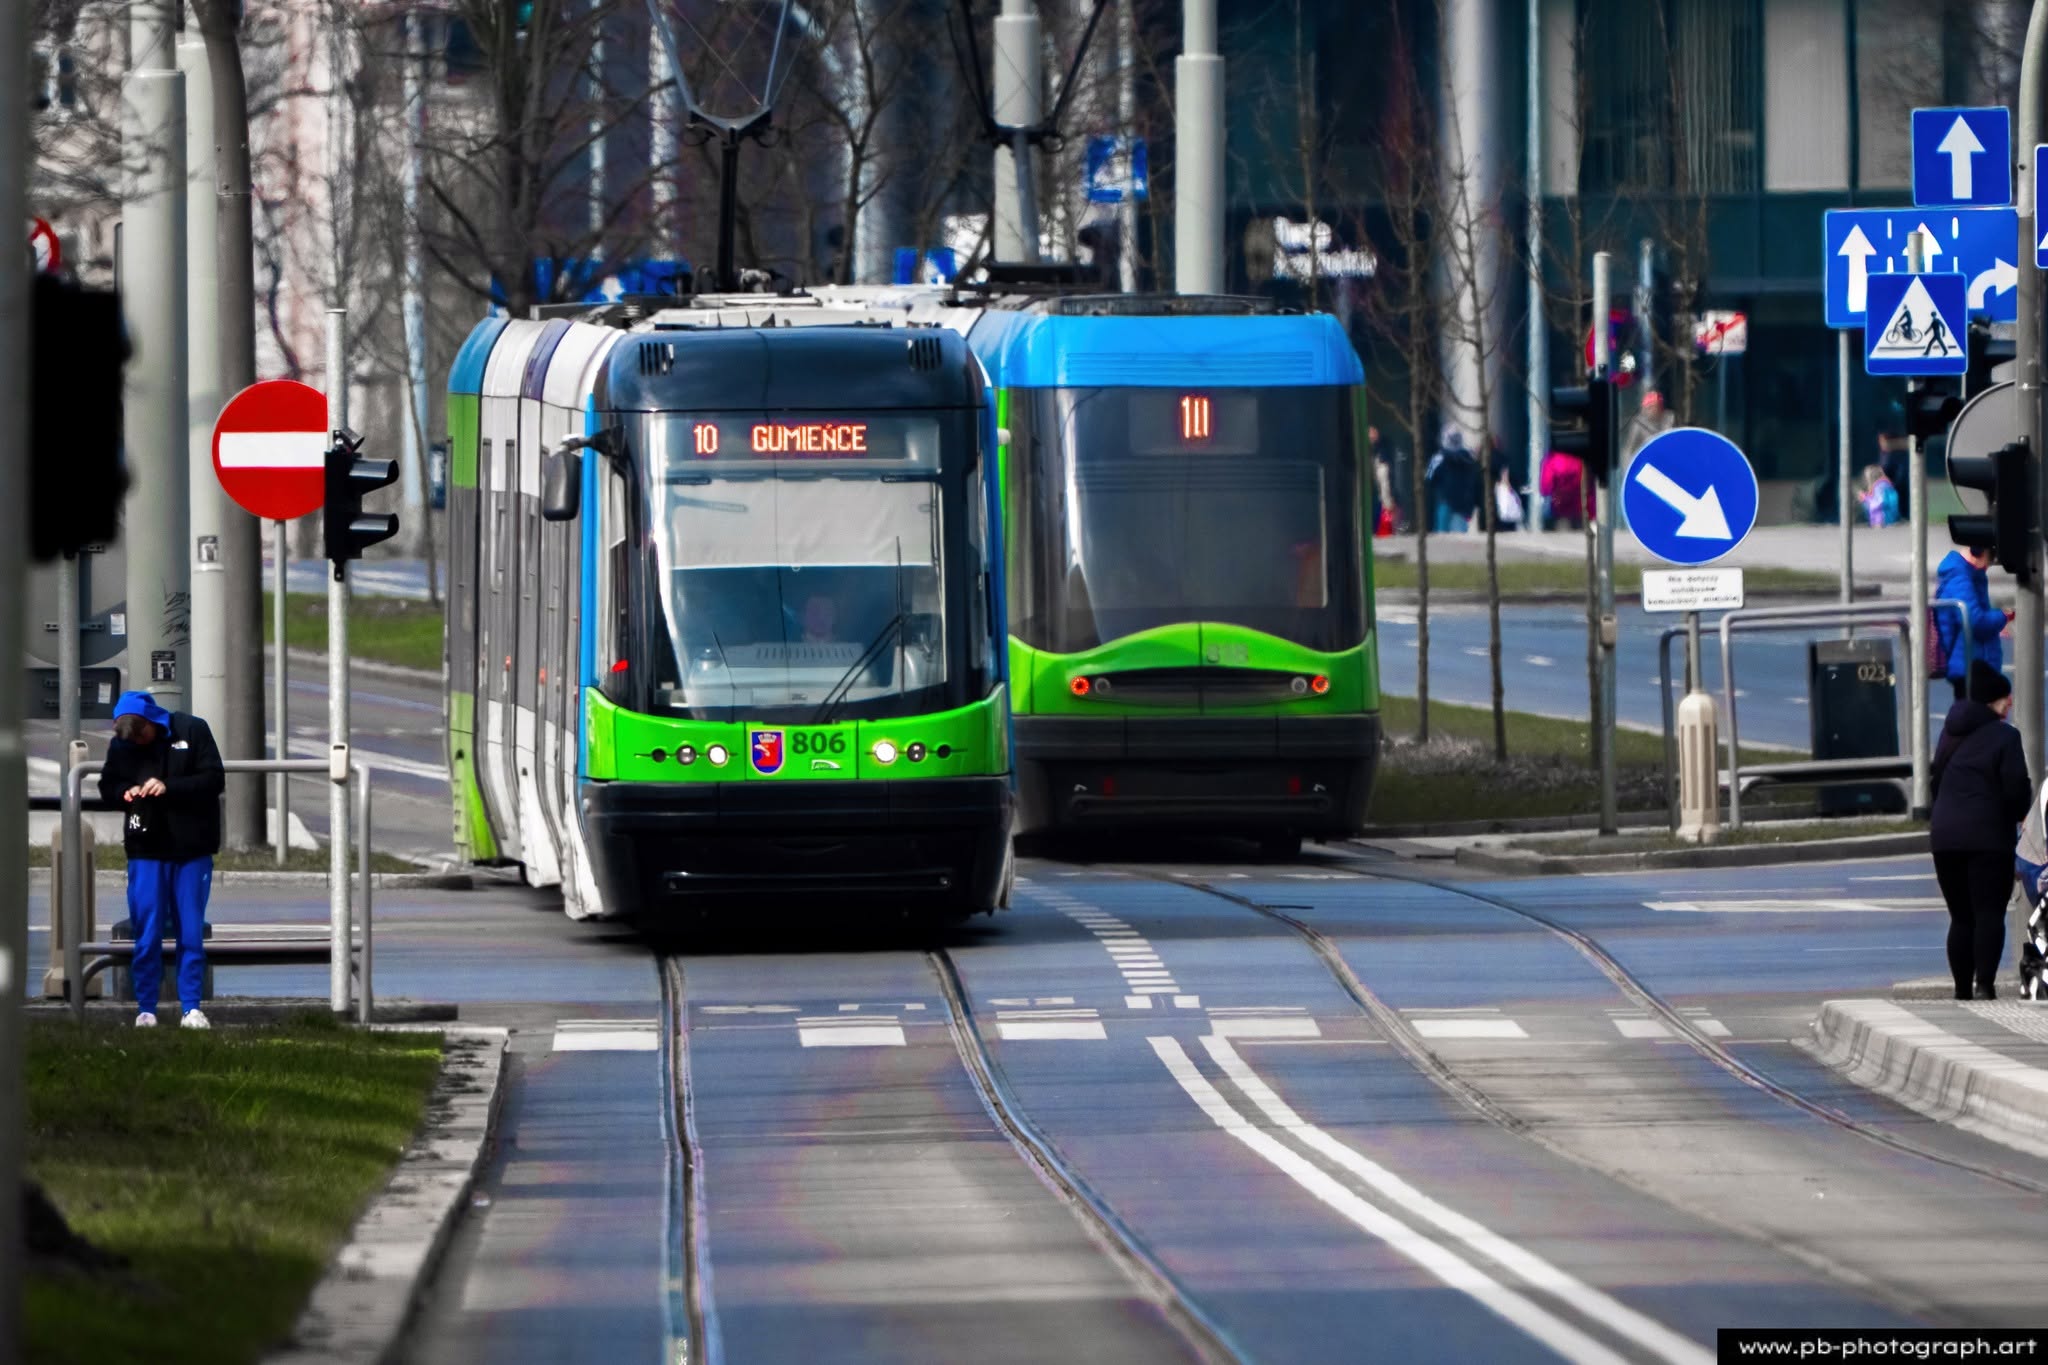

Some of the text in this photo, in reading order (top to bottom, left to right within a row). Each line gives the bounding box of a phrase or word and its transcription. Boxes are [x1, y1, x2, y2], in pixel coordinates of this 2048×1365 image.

[693, 423, 867, 453] 10 GUMIEŃCE
[1857, 663, 1887, 681] 023
[792, 731, 846, 754] 806
